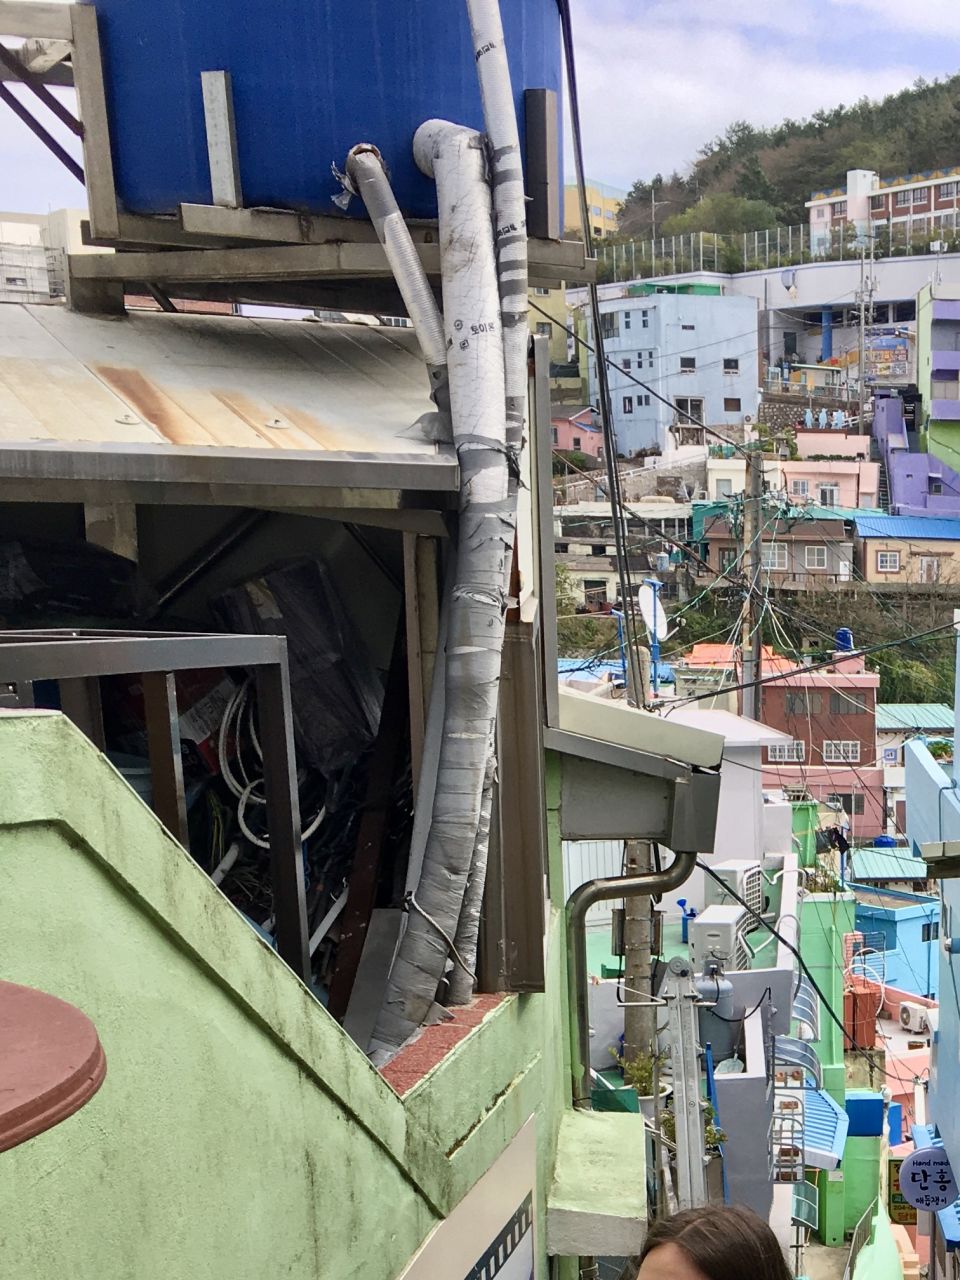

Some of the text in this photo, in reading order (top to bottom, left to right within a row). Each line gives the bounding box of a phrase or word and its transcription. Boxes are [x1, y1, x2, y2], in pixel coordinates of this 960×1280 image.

[912, 1159, 950, 1167] Hand mad
[911, 1168, 952, 1192] 단홍
[915, 1194, 947, 1207] 매듭쟁이
